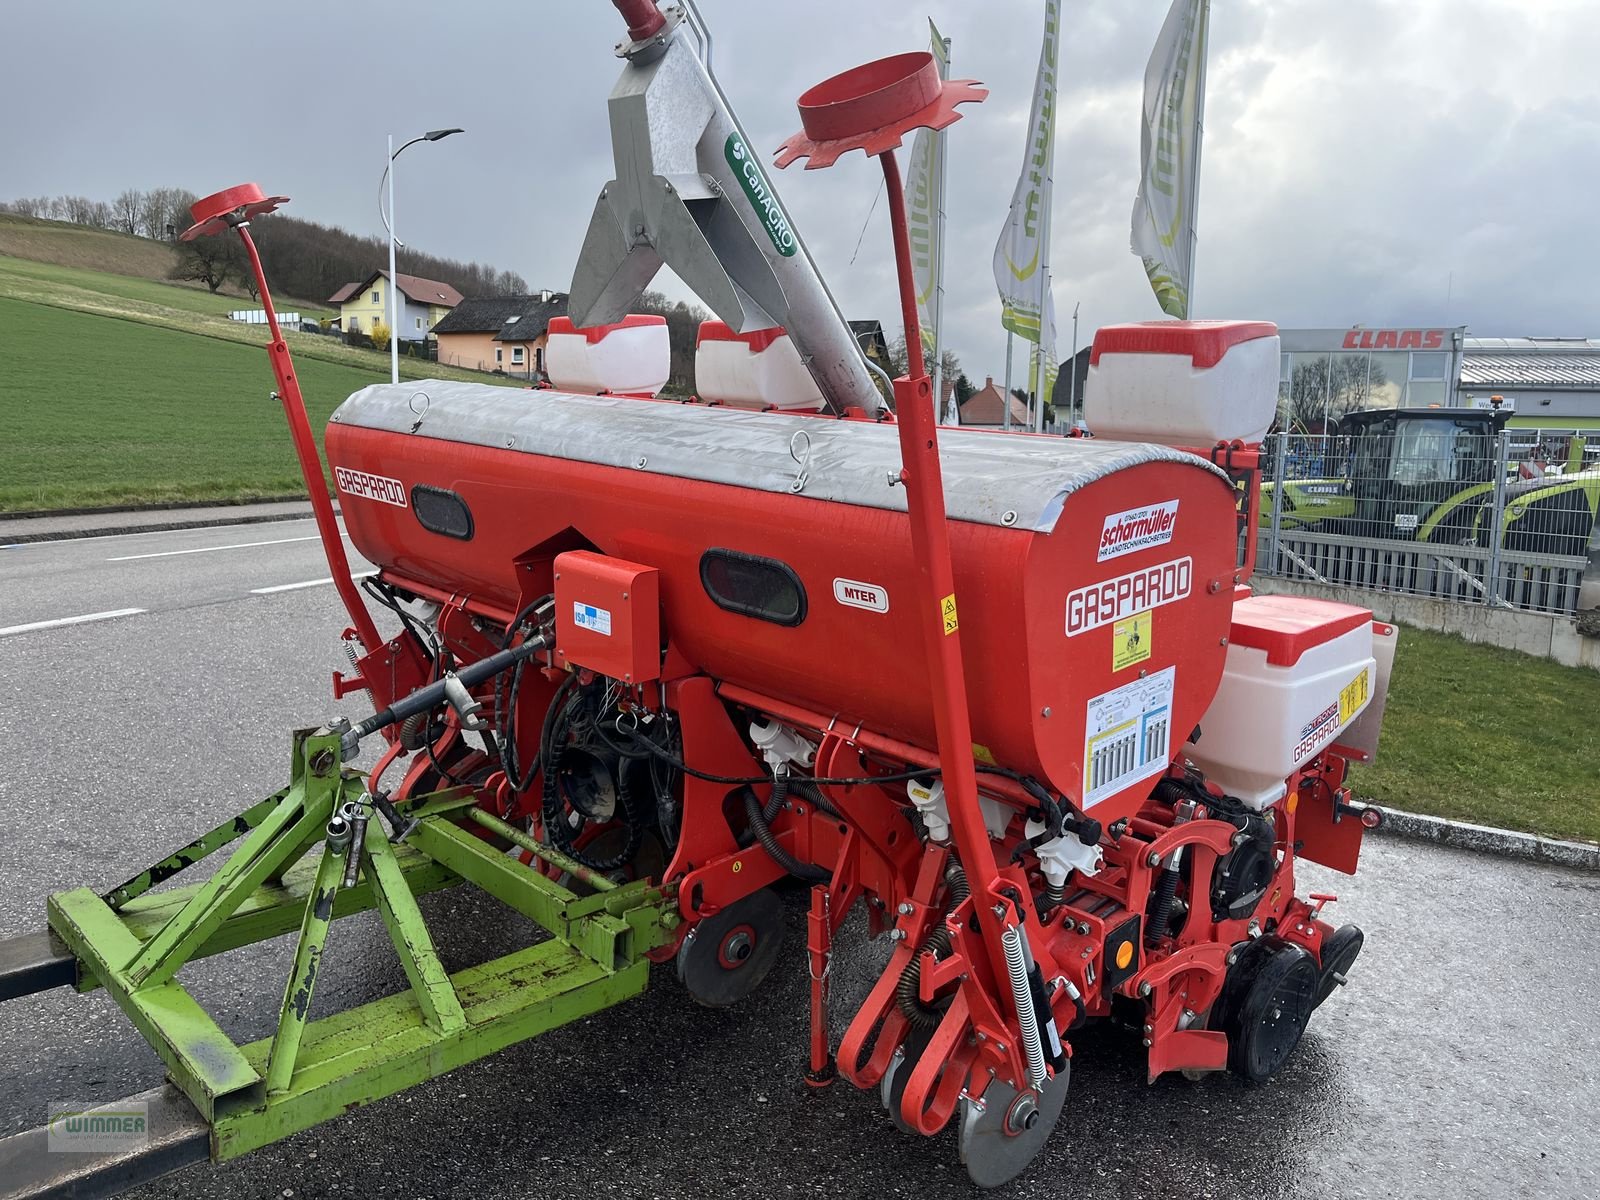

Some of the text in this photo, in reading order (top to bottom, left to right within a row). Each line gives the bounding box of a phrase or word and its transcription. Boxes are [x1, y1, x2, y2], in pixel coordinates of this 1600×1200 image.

[743, 160, 793, 248] CanAGRO
[1342, 330, 1444, 349] CLAAS
[1478, 401, 1512, 409] Wertatt
[336, 468, 406, 506] GASPARDO
[1101, 508, 1176, 547] scharmüller
[844, 586, 877, 604] MTER
[1067, 559, 1191, 633] GASPARDO
[575, 612, 586, 624] ISO
[1294, 714, 1340, 763] GASPARDO
